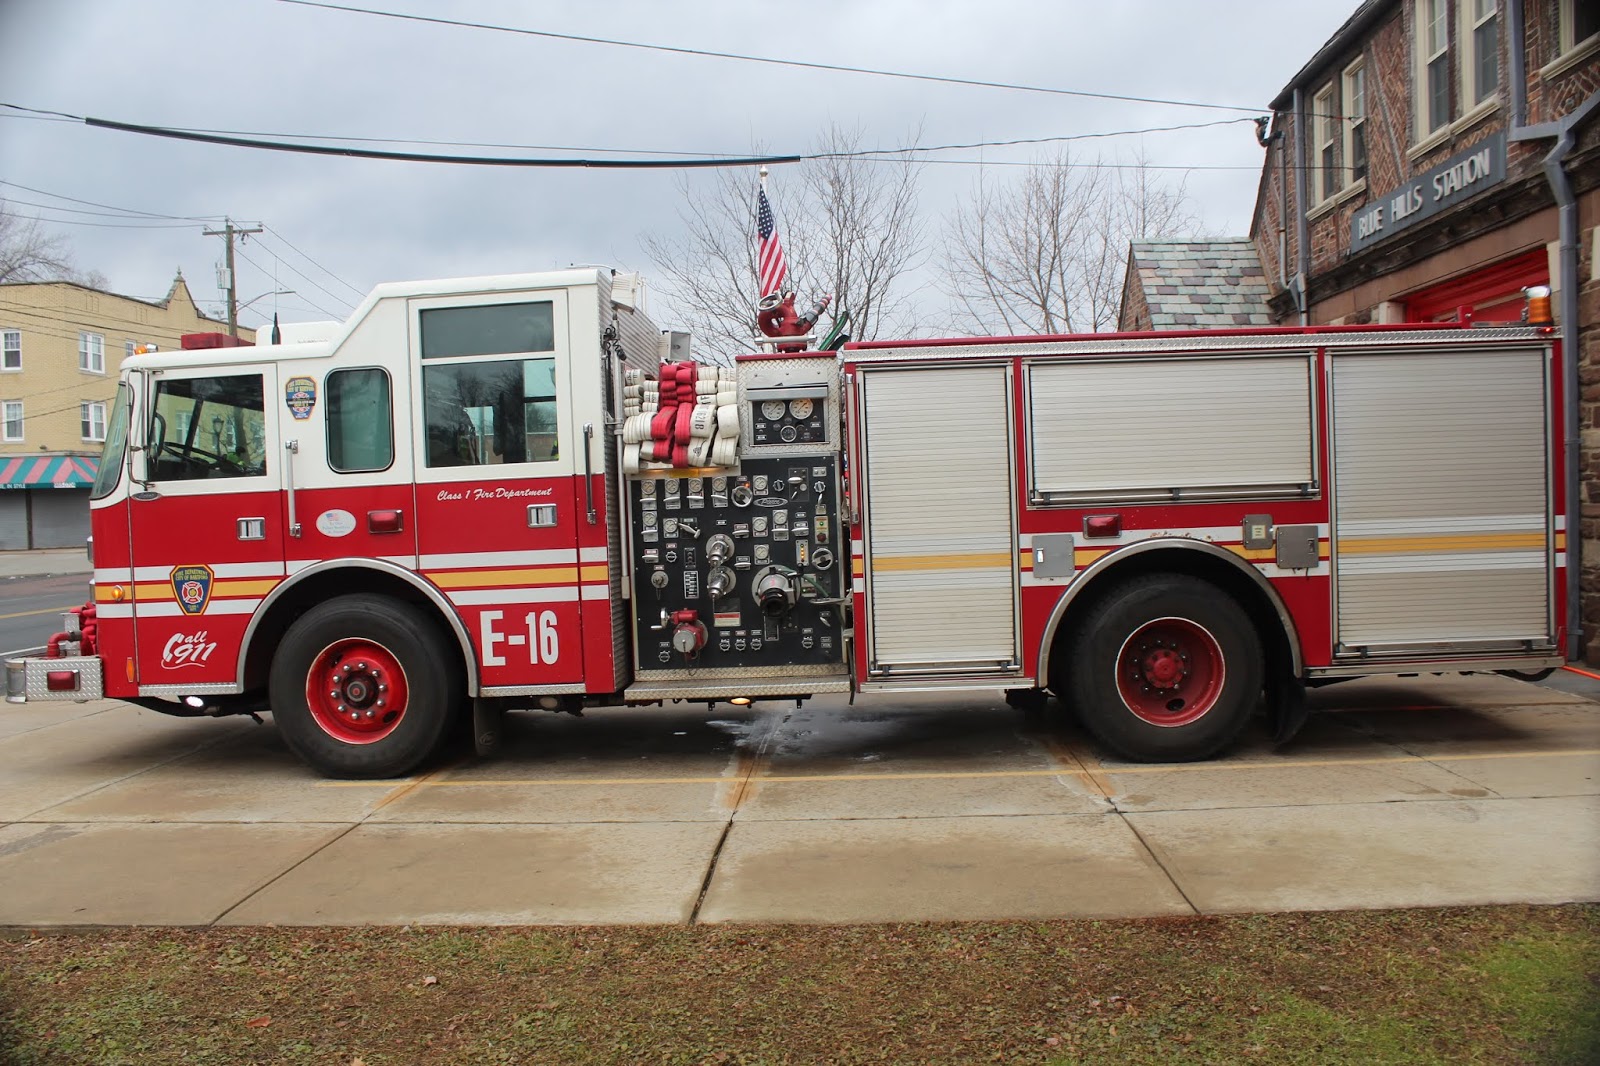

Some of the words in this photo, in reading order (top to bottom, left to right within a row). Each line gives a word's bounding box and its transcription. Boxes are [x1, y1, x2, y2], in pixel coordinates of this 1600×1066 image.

[1358, 206, 1384, 240] BLUE
[1391, 185, 1423, 223] HILLS
[1433, 148, 1490, 201] STATION
[437, 490, 462, 501] Class
[465, 490, 471, 500] 1
[473, 488, 495, 501] Fire
[495, 487, 552, 500] Department
[163, 631, 207, 662] Call
[173, 642, 217, 664] 911
[480, 610, 559, 667] E-16
